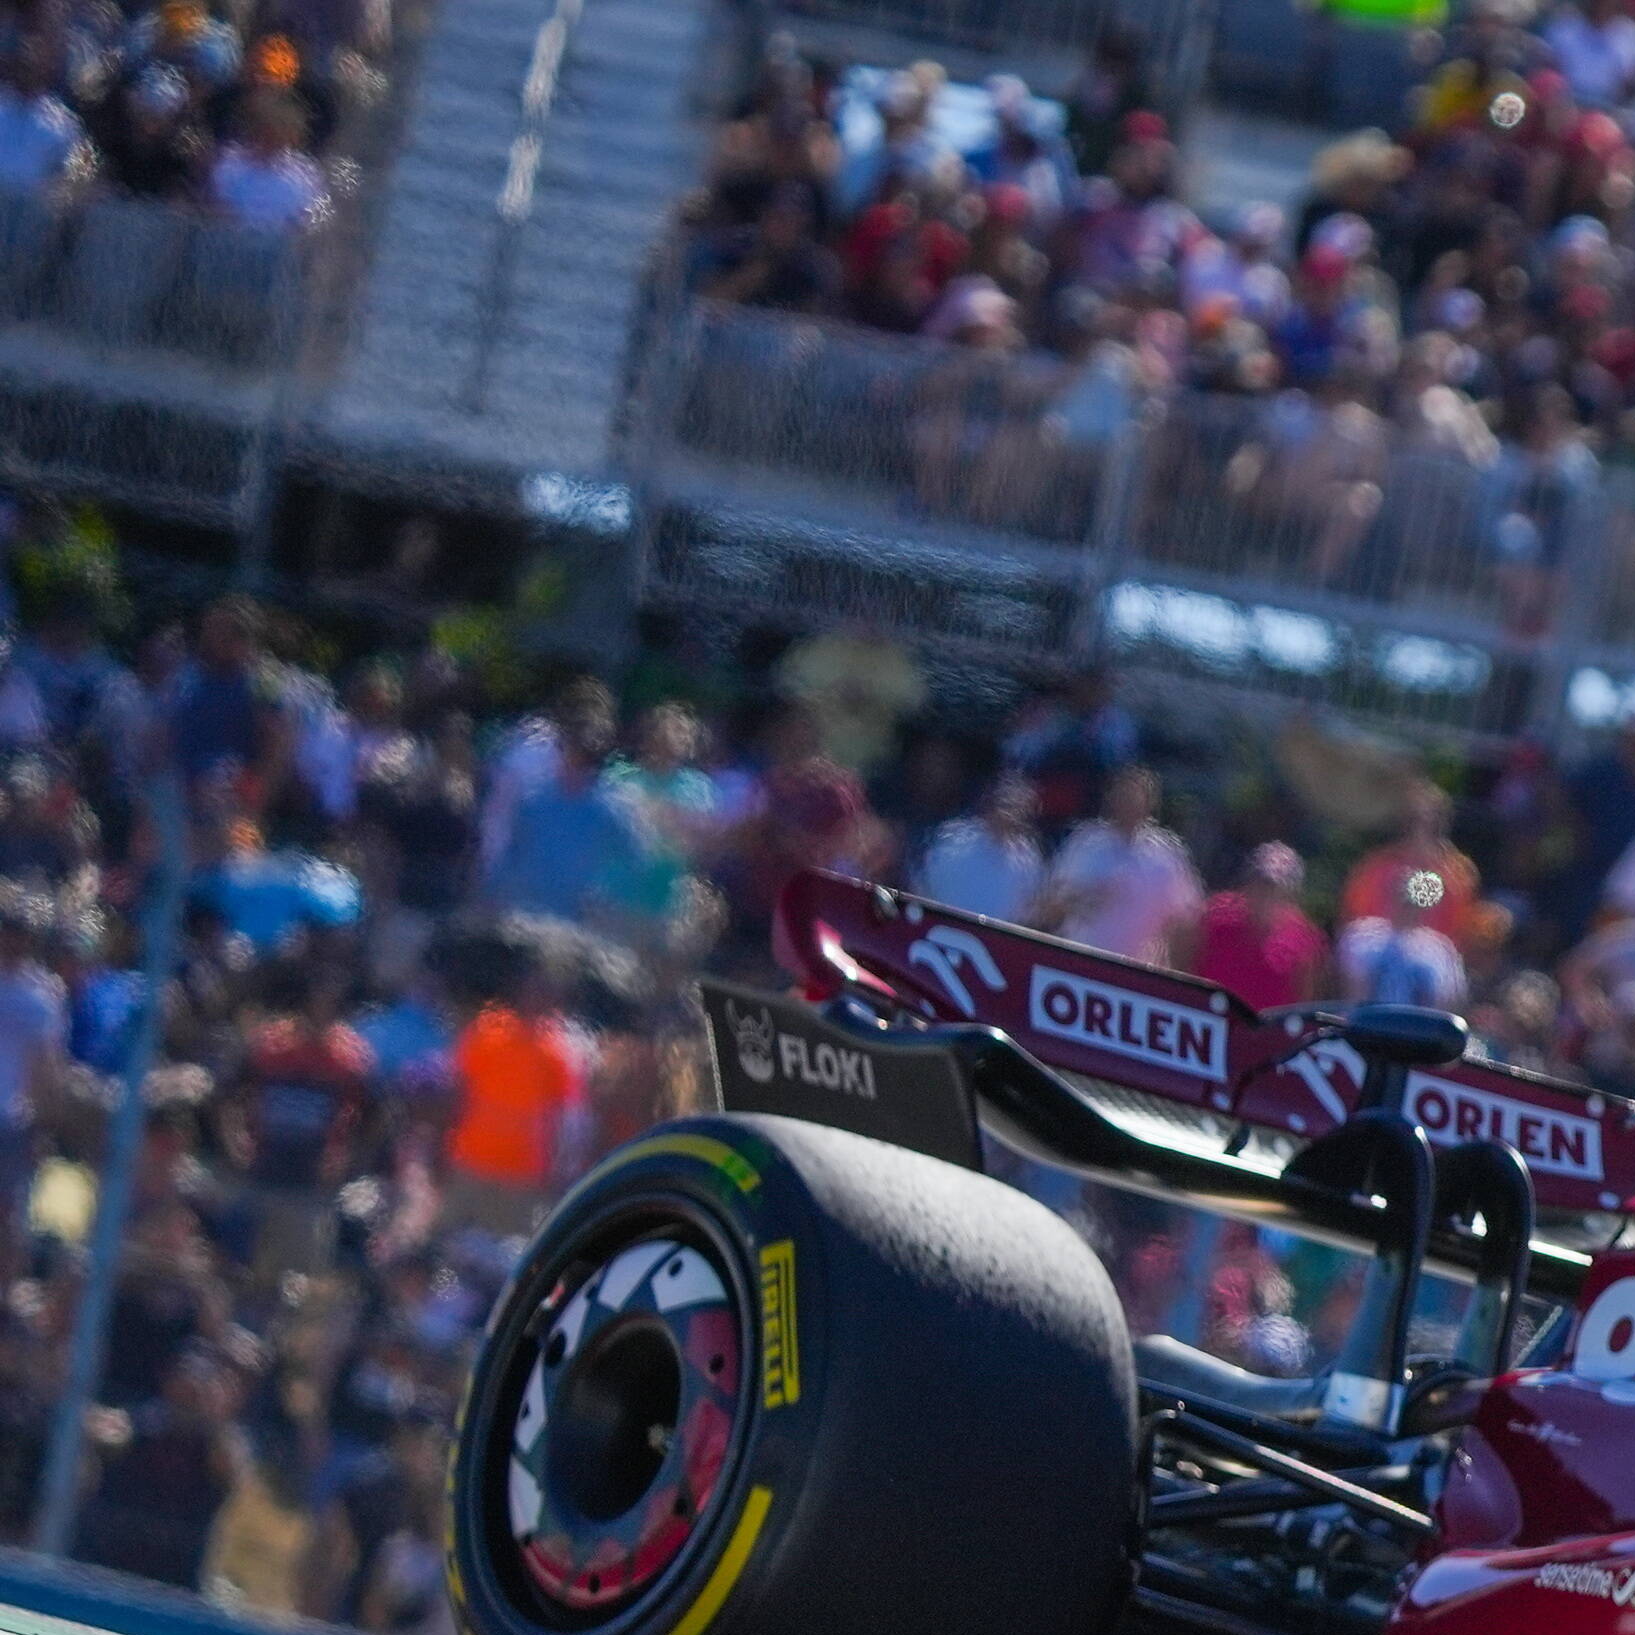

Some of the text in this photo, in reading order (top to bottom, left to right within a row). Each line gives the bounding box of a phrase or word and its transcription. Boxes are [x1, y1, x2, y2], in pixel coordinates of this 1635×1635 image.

[777, 1032, 877, 1100] FLOKI
[1041, 979, 1212, 1066] ORLEN
[759, 1239, 800, 1410] PIRELLI
